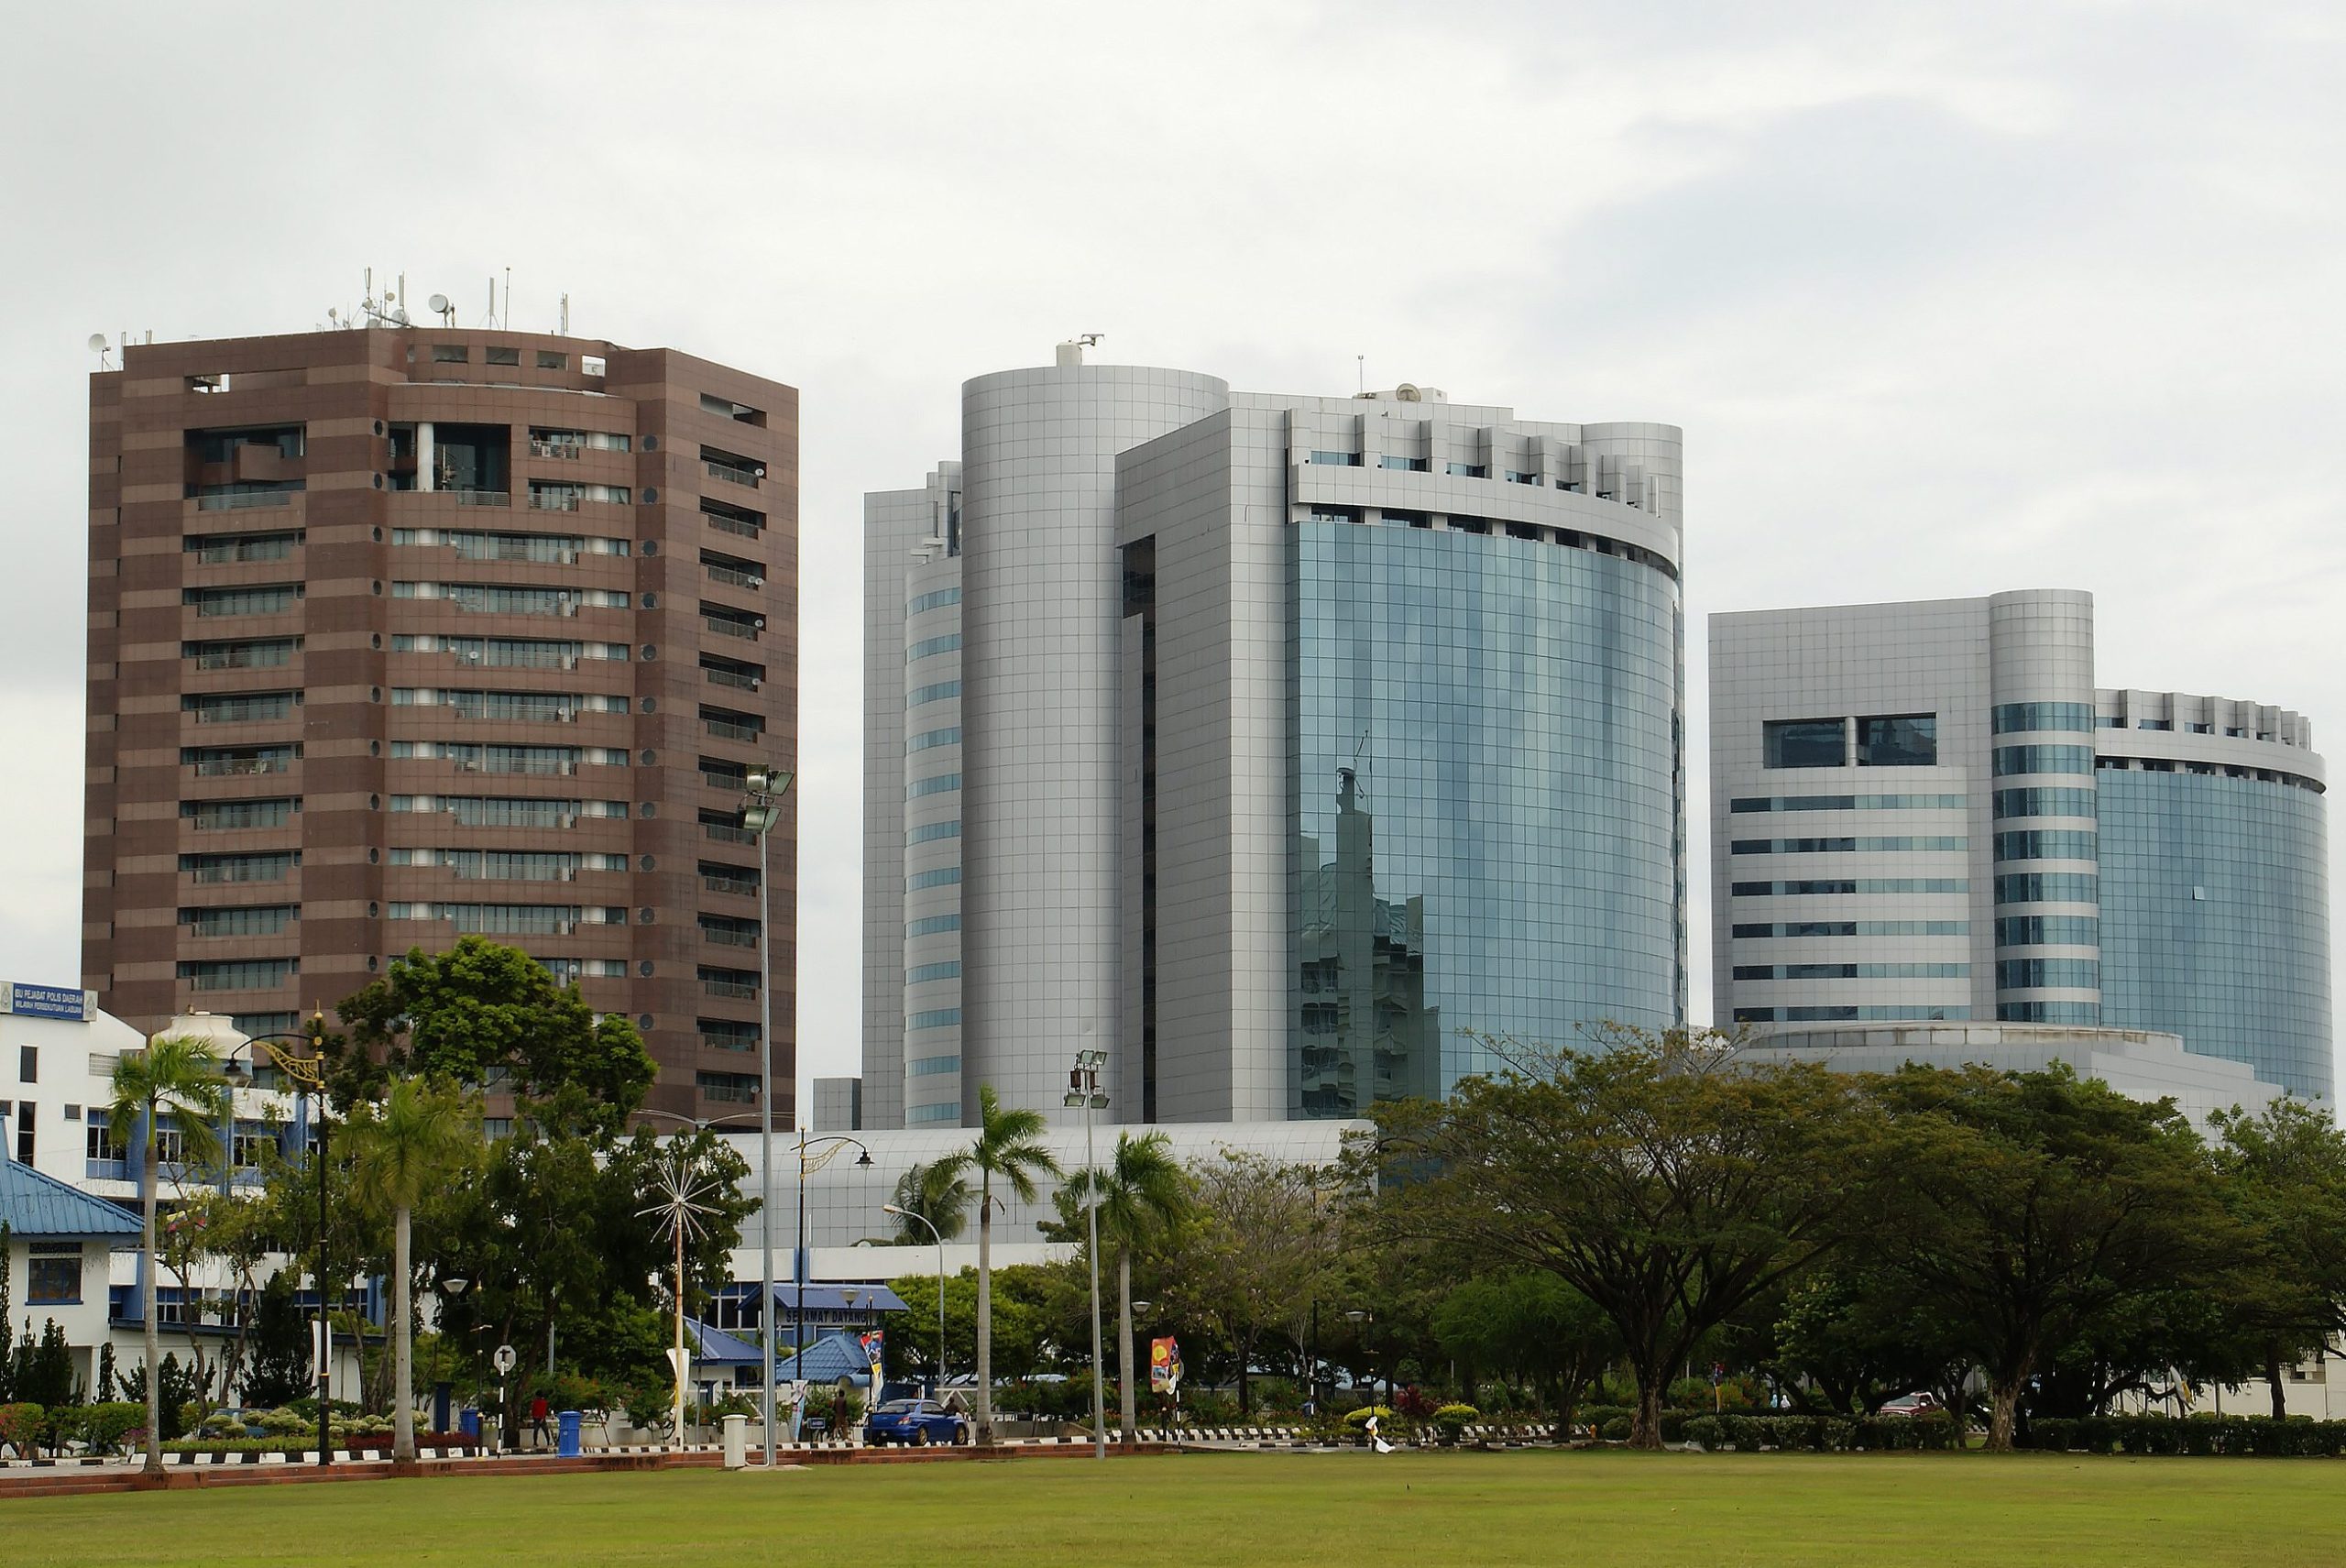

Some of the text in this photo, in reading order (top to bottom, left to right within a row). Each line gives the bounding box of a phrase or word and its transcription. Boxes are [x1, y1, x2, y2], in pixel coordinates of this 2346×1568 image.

[15, 989, 83, 1004] IBU PEJABAT POLIS DAERAH
[15, 1001, 82, 1014] WILAYAH PERSEKUTUAN LABUAN
[786, 1310, 866, 1322] SEAMAT DATANG
